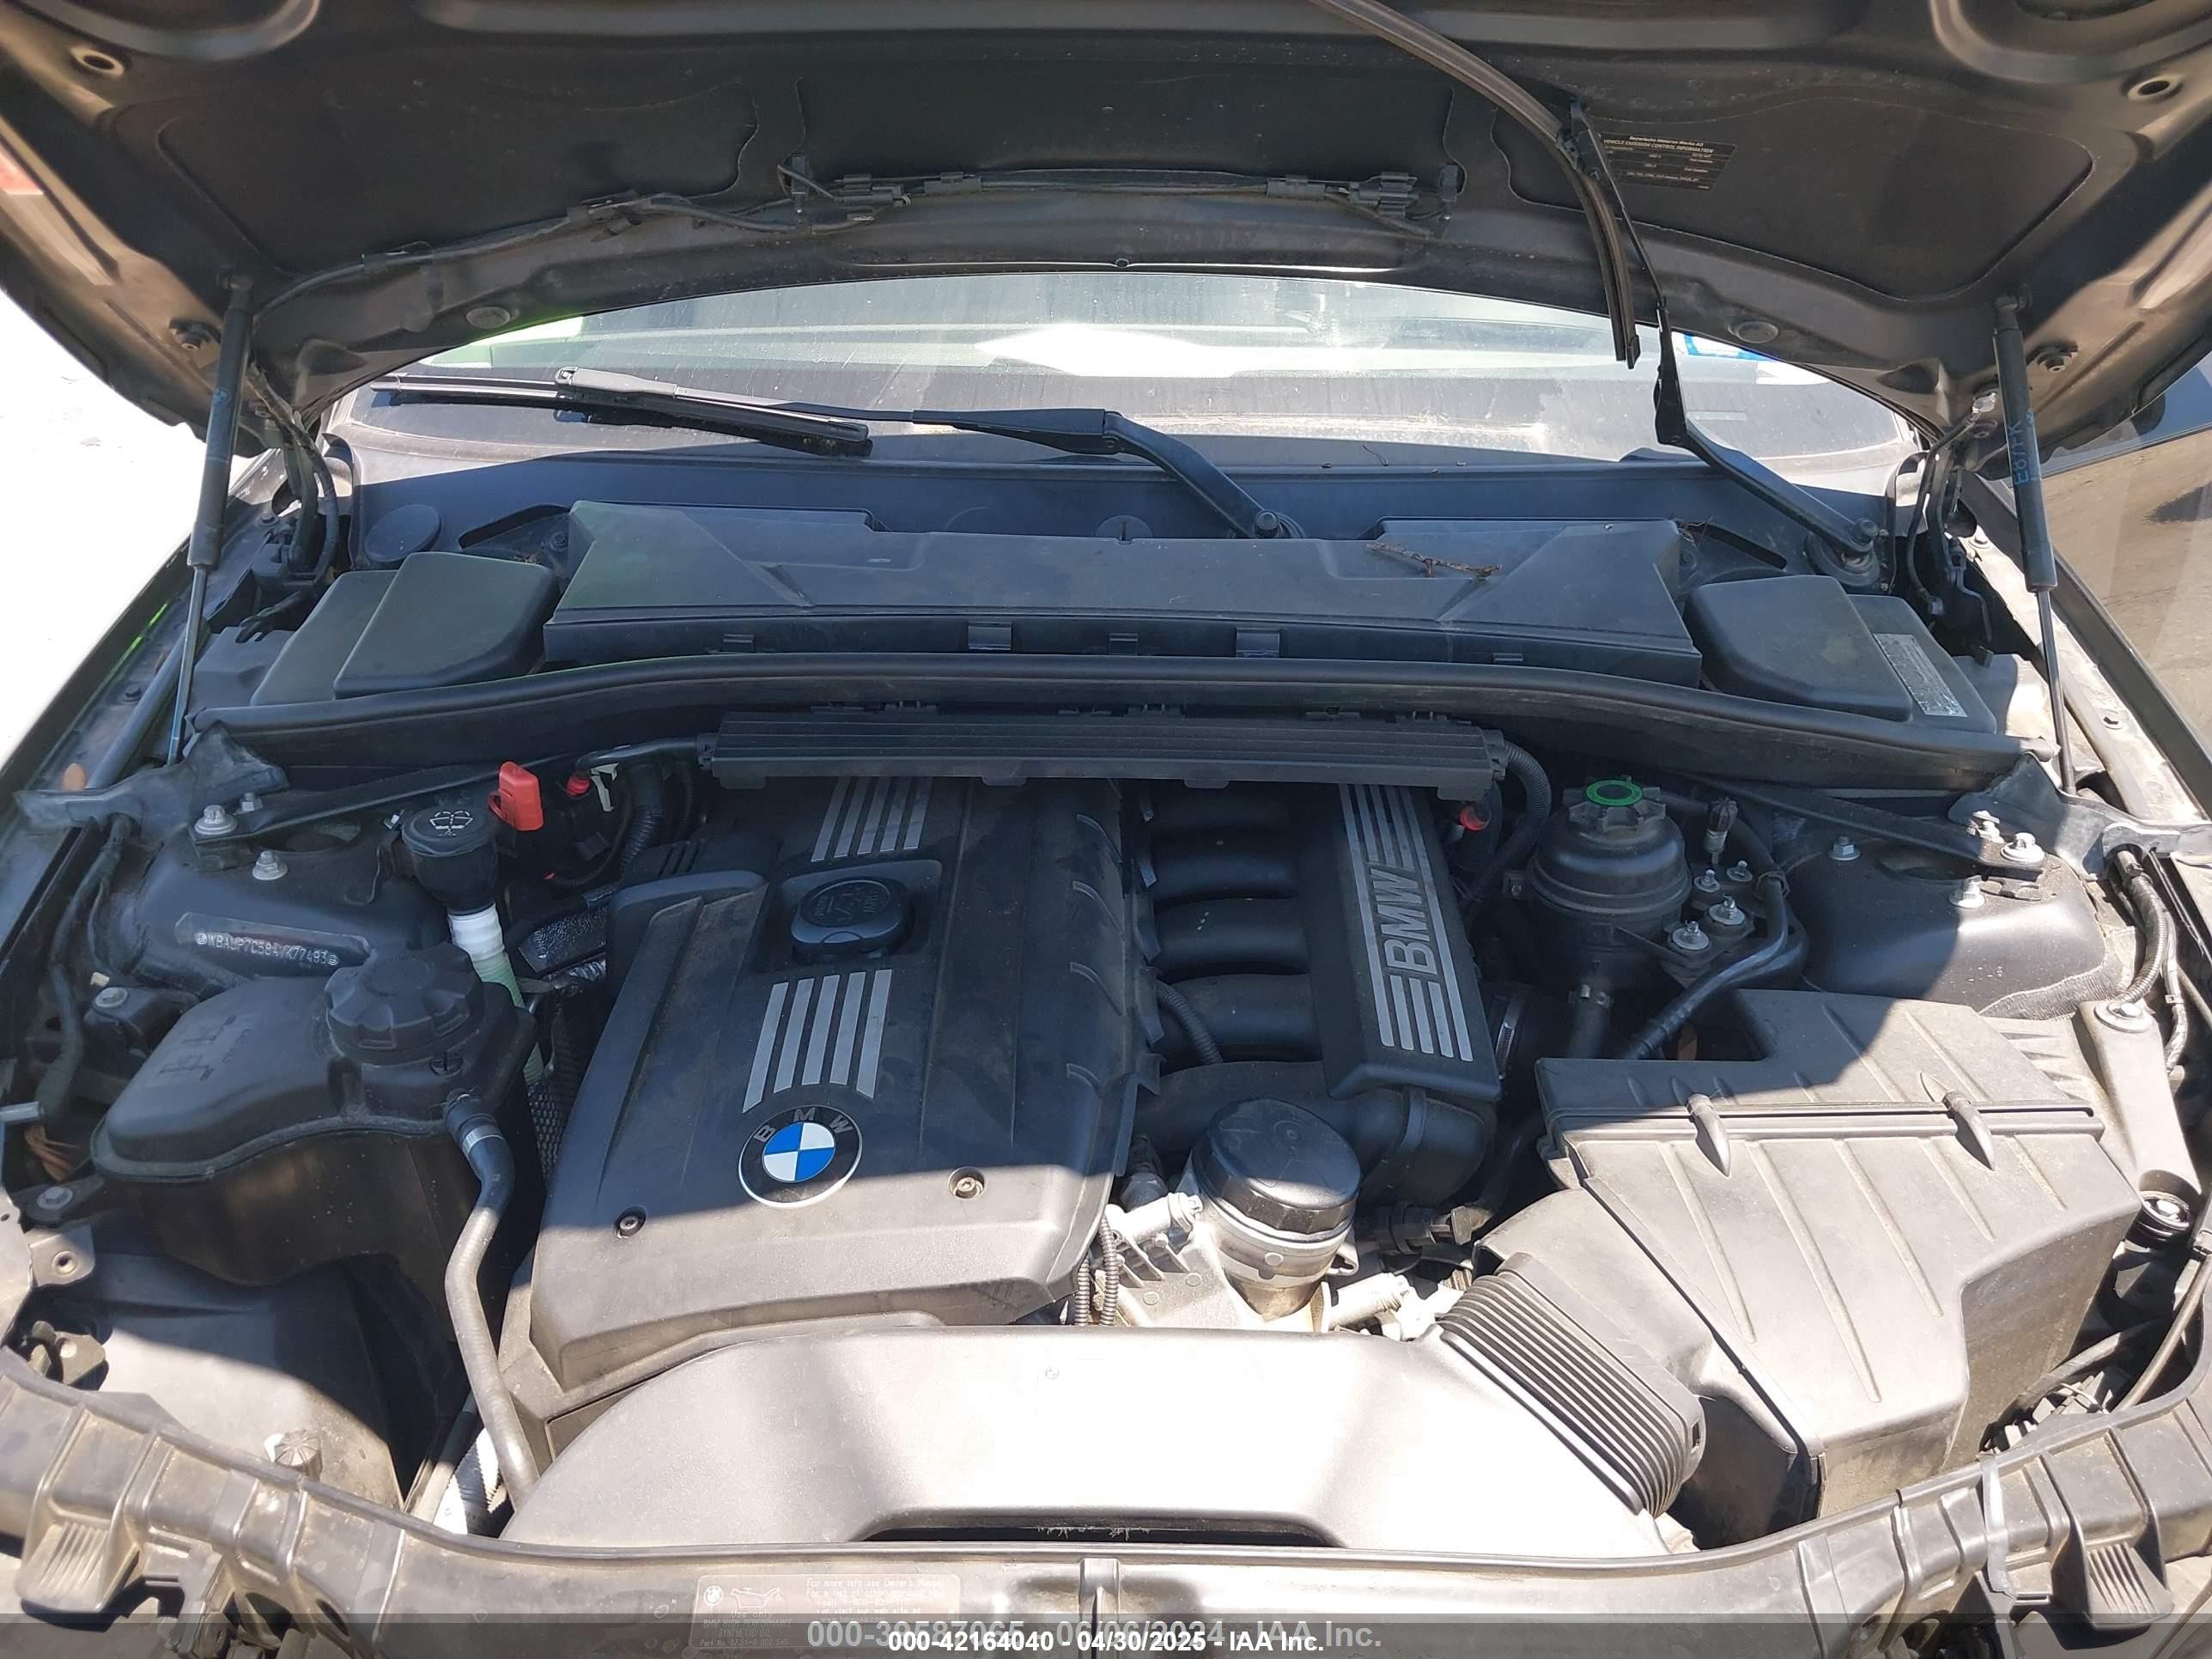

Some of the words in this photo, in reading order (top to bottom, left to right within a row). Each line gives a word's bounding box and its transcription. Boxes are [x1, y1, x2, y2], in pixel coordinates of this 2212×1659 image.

[1676, 145, 1714, 154] INFORMATION
[1370, 867, 1438, 975] BMW
[753, 1107, 854, 1143] BMW
[805, 1578, 820, 1588] For
[823, 1579, 843, 1588] more
[743, 1619, 793, 1628] PERFORMANCE
[718, 1628, 756, 1638] SYNTHETIC
